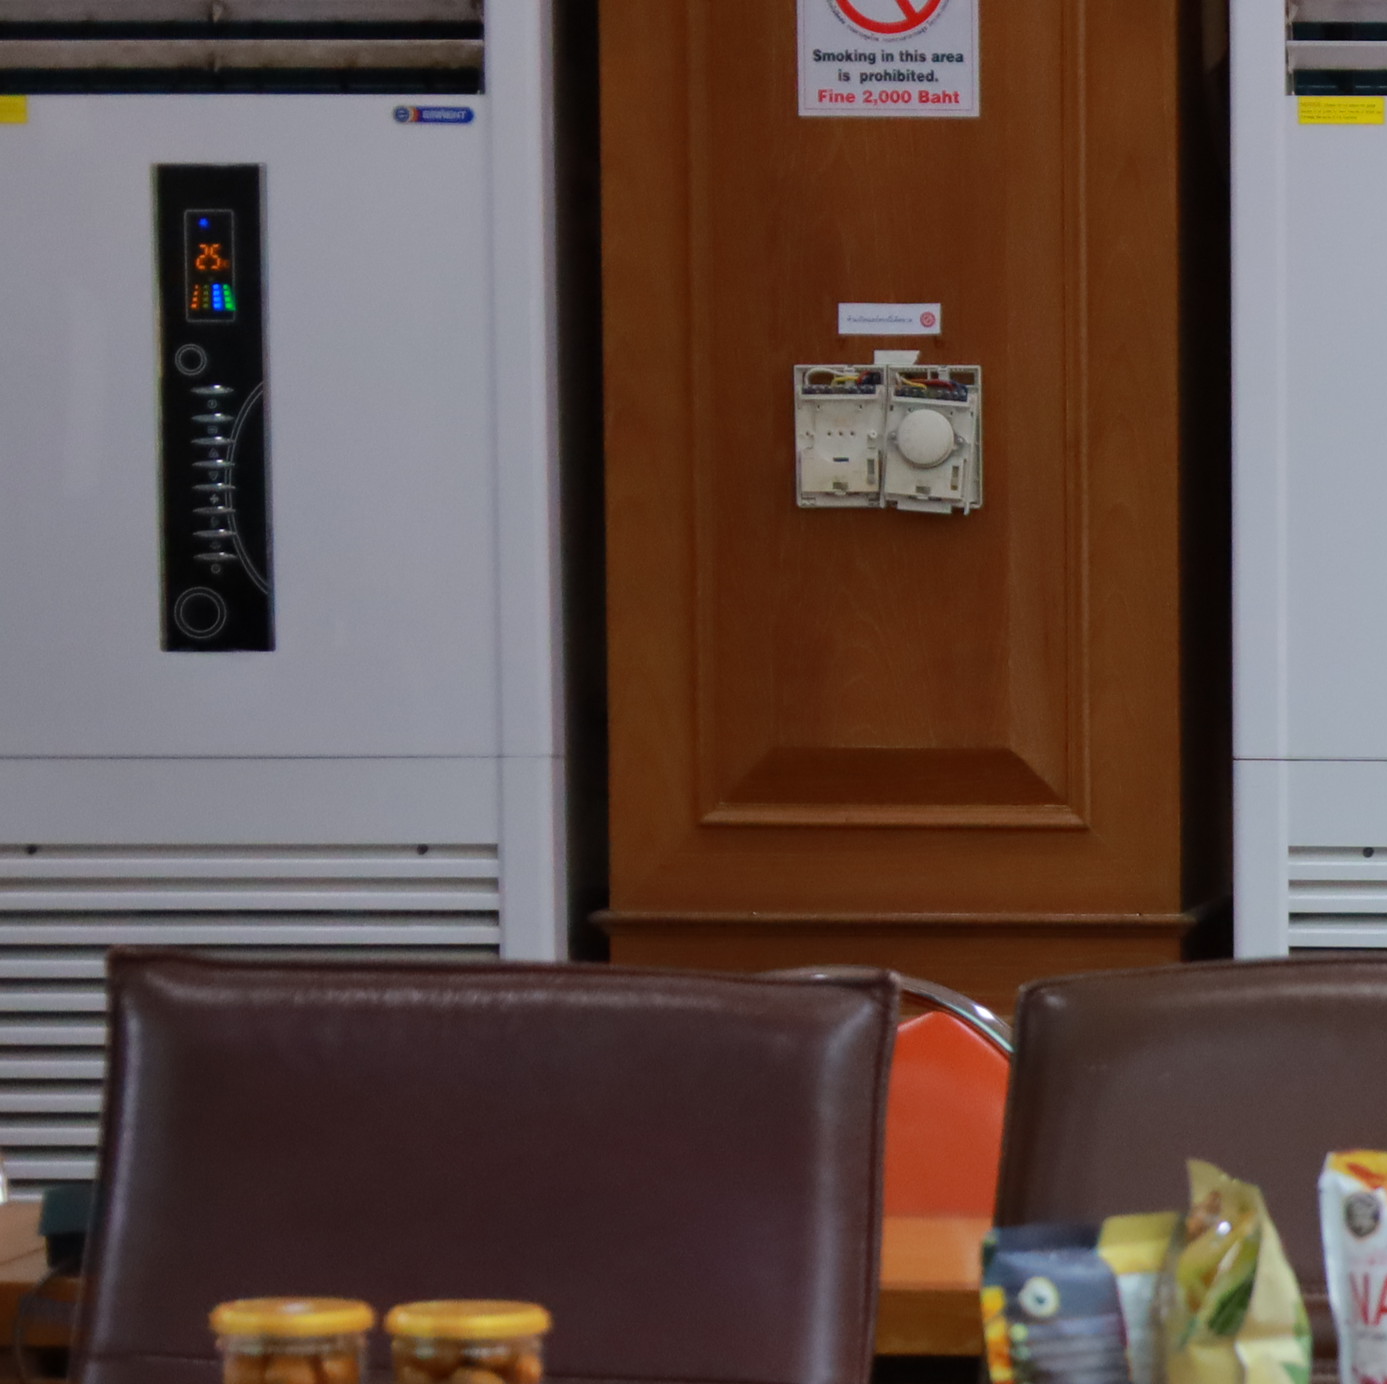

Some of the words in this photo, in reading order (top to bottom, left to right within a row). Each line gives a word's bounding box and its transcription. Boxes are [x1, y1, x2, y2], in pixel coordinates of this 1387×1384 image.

[812, 49, 877, 65] Smoking
[881, 49, 894, 63] in
[899, 49, 927, 63] this
[931, 52, 964, 63] area
[838, 68, 850, 82] is
[859, 69, 939, 84] prohibited.
[817, 89, 856, 104] Fine
[862, 90, 912, 106] 2,000
[917, 90, 960, 104] Baht
[195, 243, 221, 270] 25
